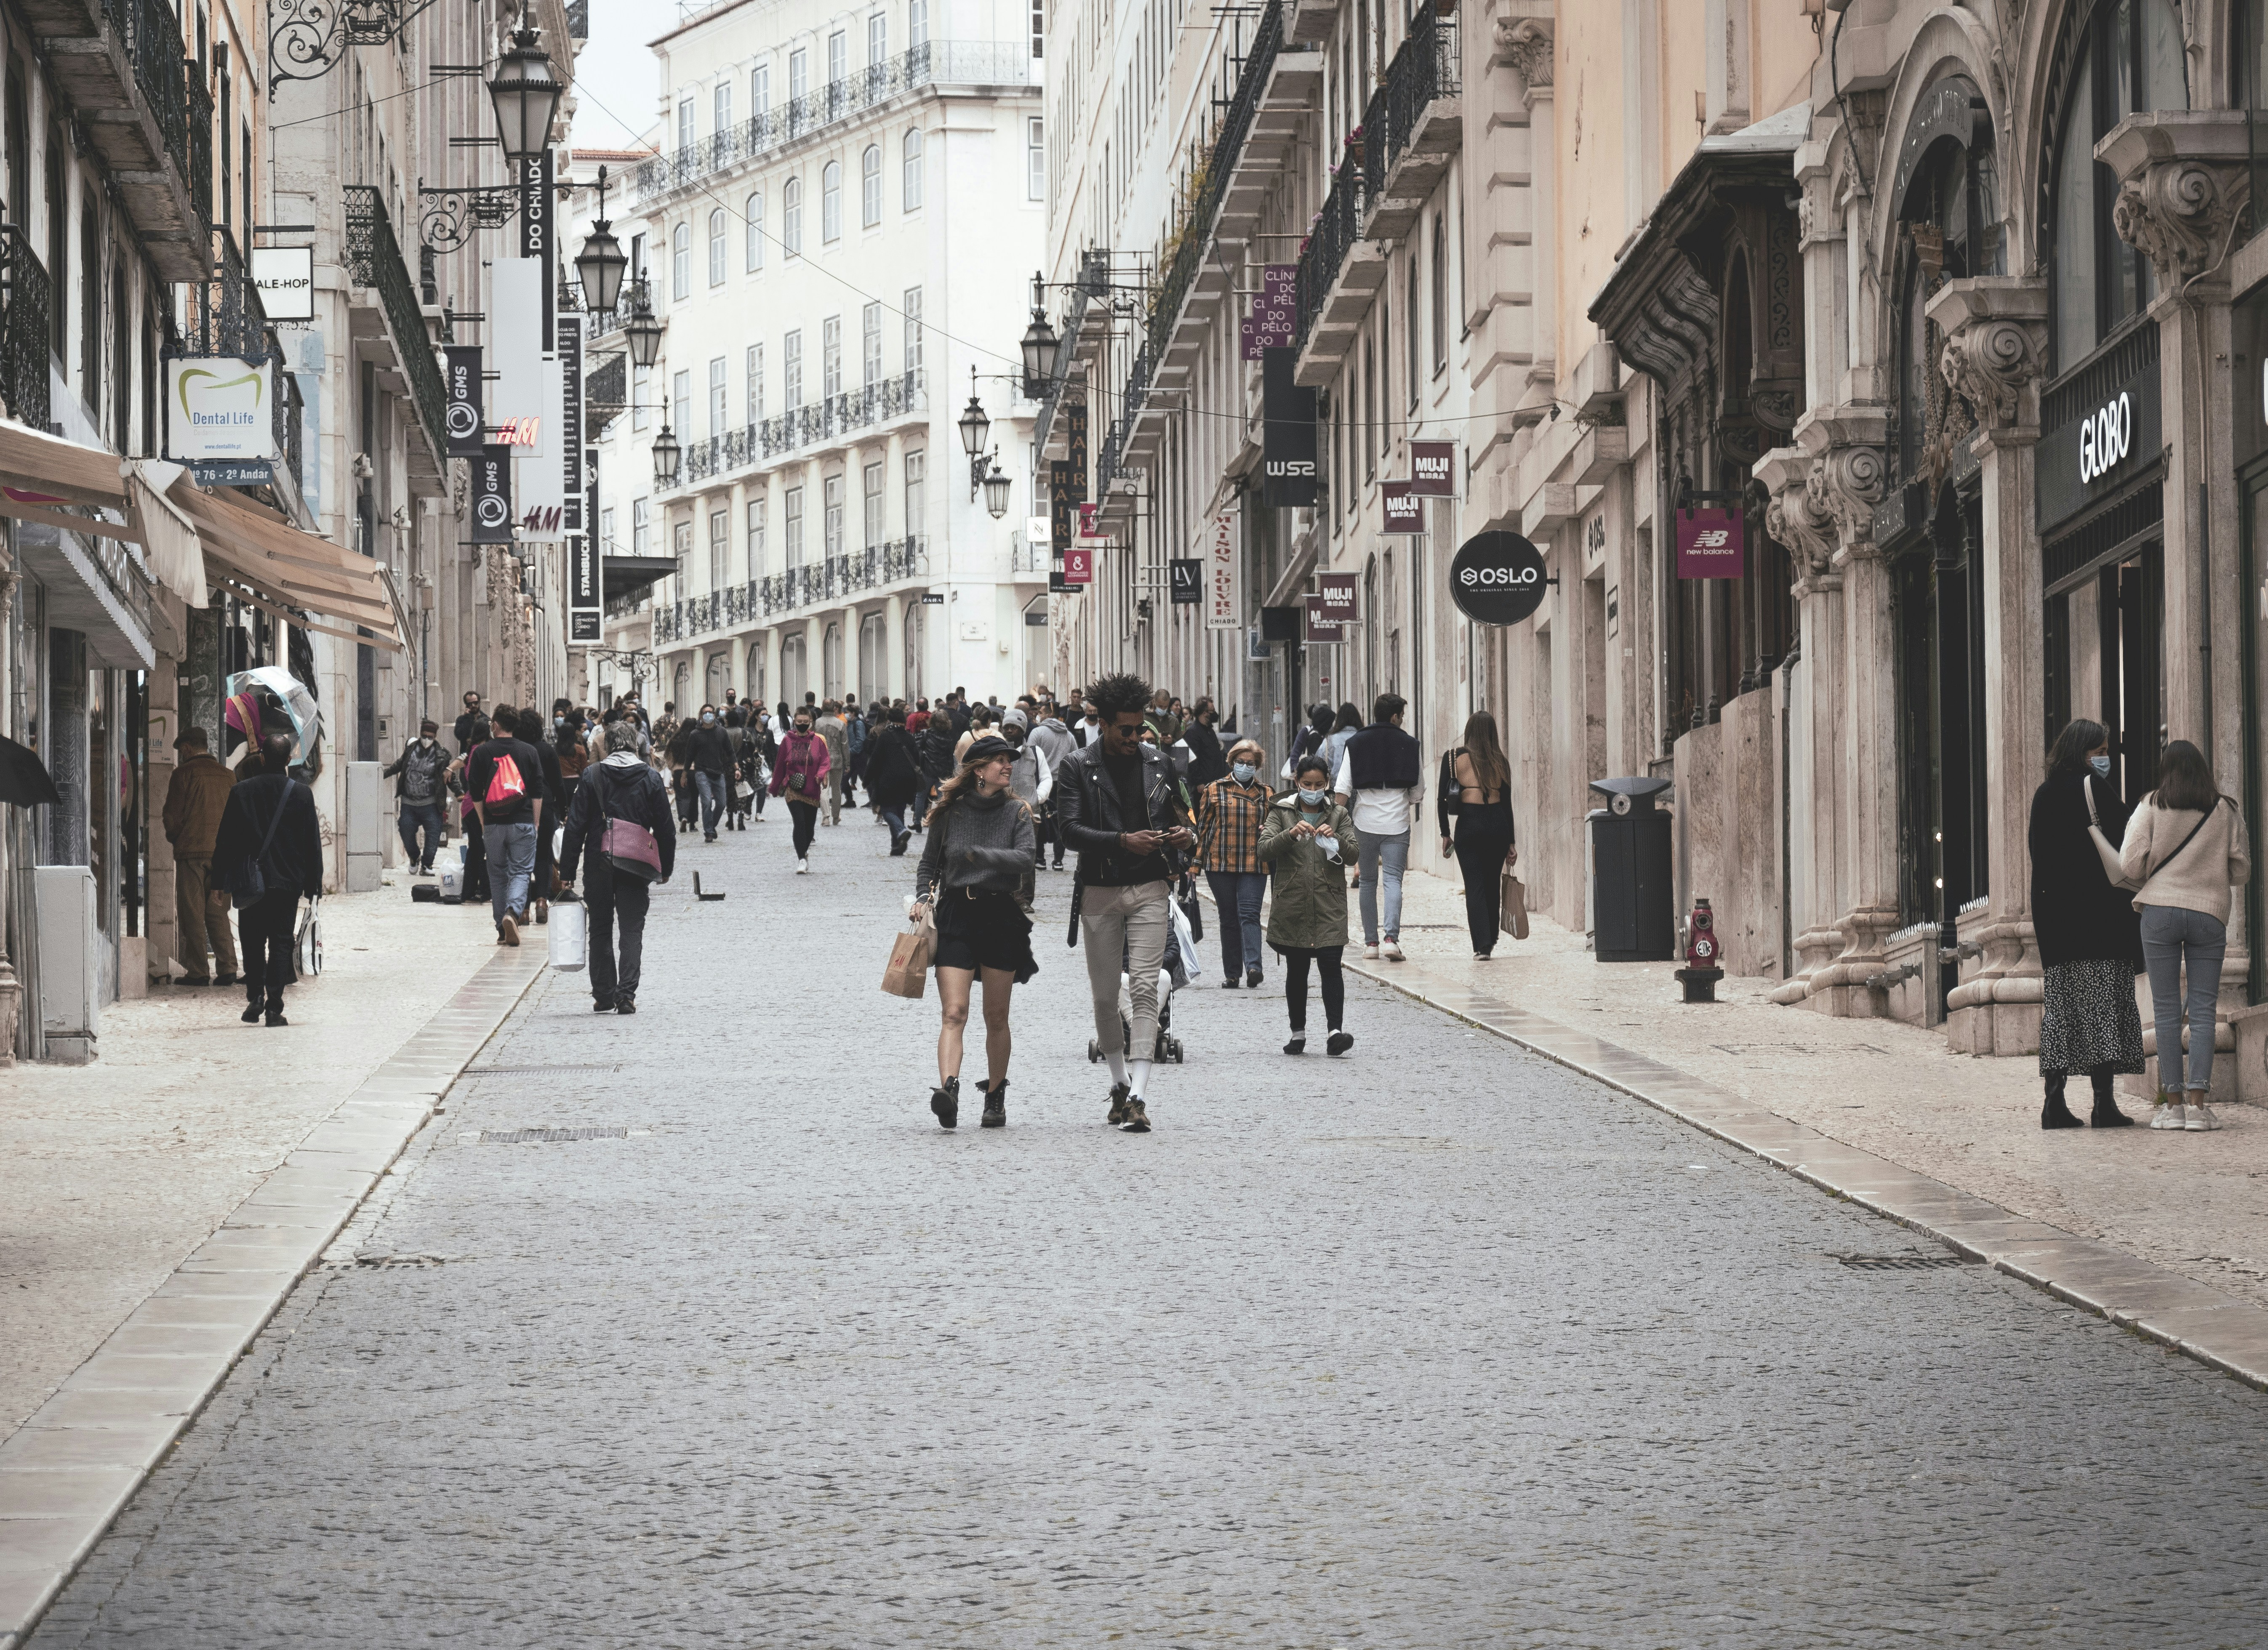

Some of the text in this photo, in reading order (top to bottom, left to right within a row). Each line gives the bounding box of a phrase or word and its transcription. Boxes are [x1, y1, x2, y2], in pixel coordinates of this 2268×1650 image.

[529, 224, 542, 249] DO
[1265, 269, 1295, 281] CLÍNI
[257, 279, 309, 289] ALE-HOP
[1274, 290, 1295, 305] PÊL
[1268, 311, 1285, 320] DO
[1261, 321, 1291, 332] PÊLO
[1256, 336, 1273, 345] DO
[1250, 346, 1263, 357] PÊ
[455, 366, 467, 399] GMS
[193, 412, 253, 425] Dental Life
[2080, 391, 2130, 484] GLOBO
[1072, 418, 1086, 486] HAIR
[1415, 458, 1449, 472] MUJI
[203, 470, 216, 480] 76
[226, 470, 237, 479] 2º
[240, 469, 268, 479] Andar
[486, 461, 497, 492] GMS
[1054, 471, 1069, 536] HAIR
[1387, 497, 1419, 511] MUJI
[1594, 514, 1604, 552] OSL
[581, 533, 590, 597] STARBUCK
[1480, 567, 1537, 584] OSLO
[1323, 588, 1352, 600] MUJI
